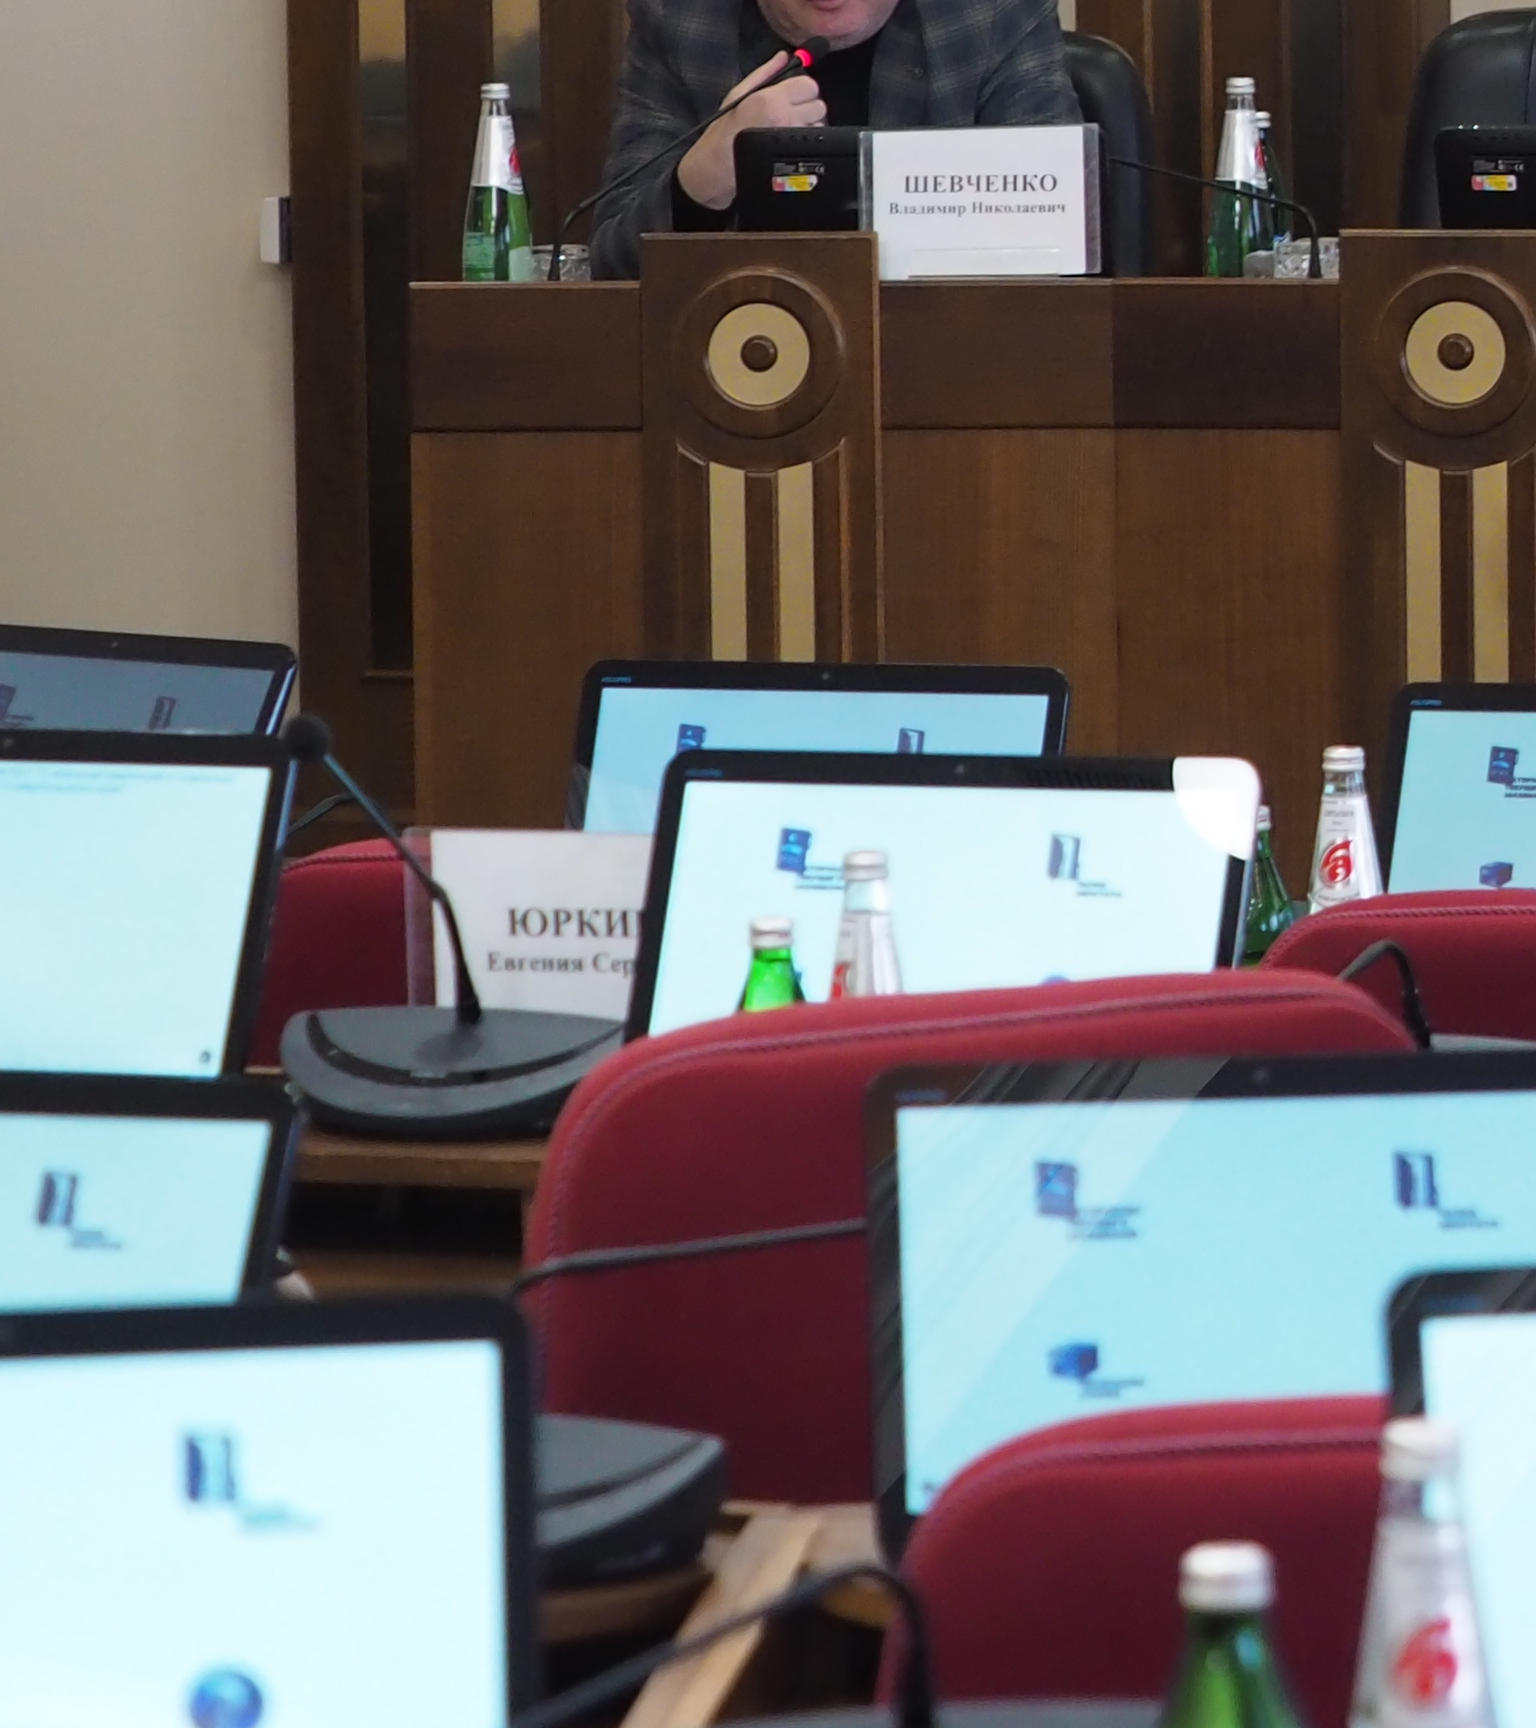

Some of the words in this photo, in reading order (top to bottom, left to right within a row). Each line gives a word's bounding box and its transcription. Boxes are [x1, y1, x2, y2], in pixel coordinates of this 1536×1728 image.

[903, 173, 1058, 193] ШЕВЧЕНКО
[888, 201, 966, 217] Владимир
[971, 200, 1066, 214] Николаевич
[487, 950, 583, 972] Евгения
[592, 952, 636, 978] Сер
